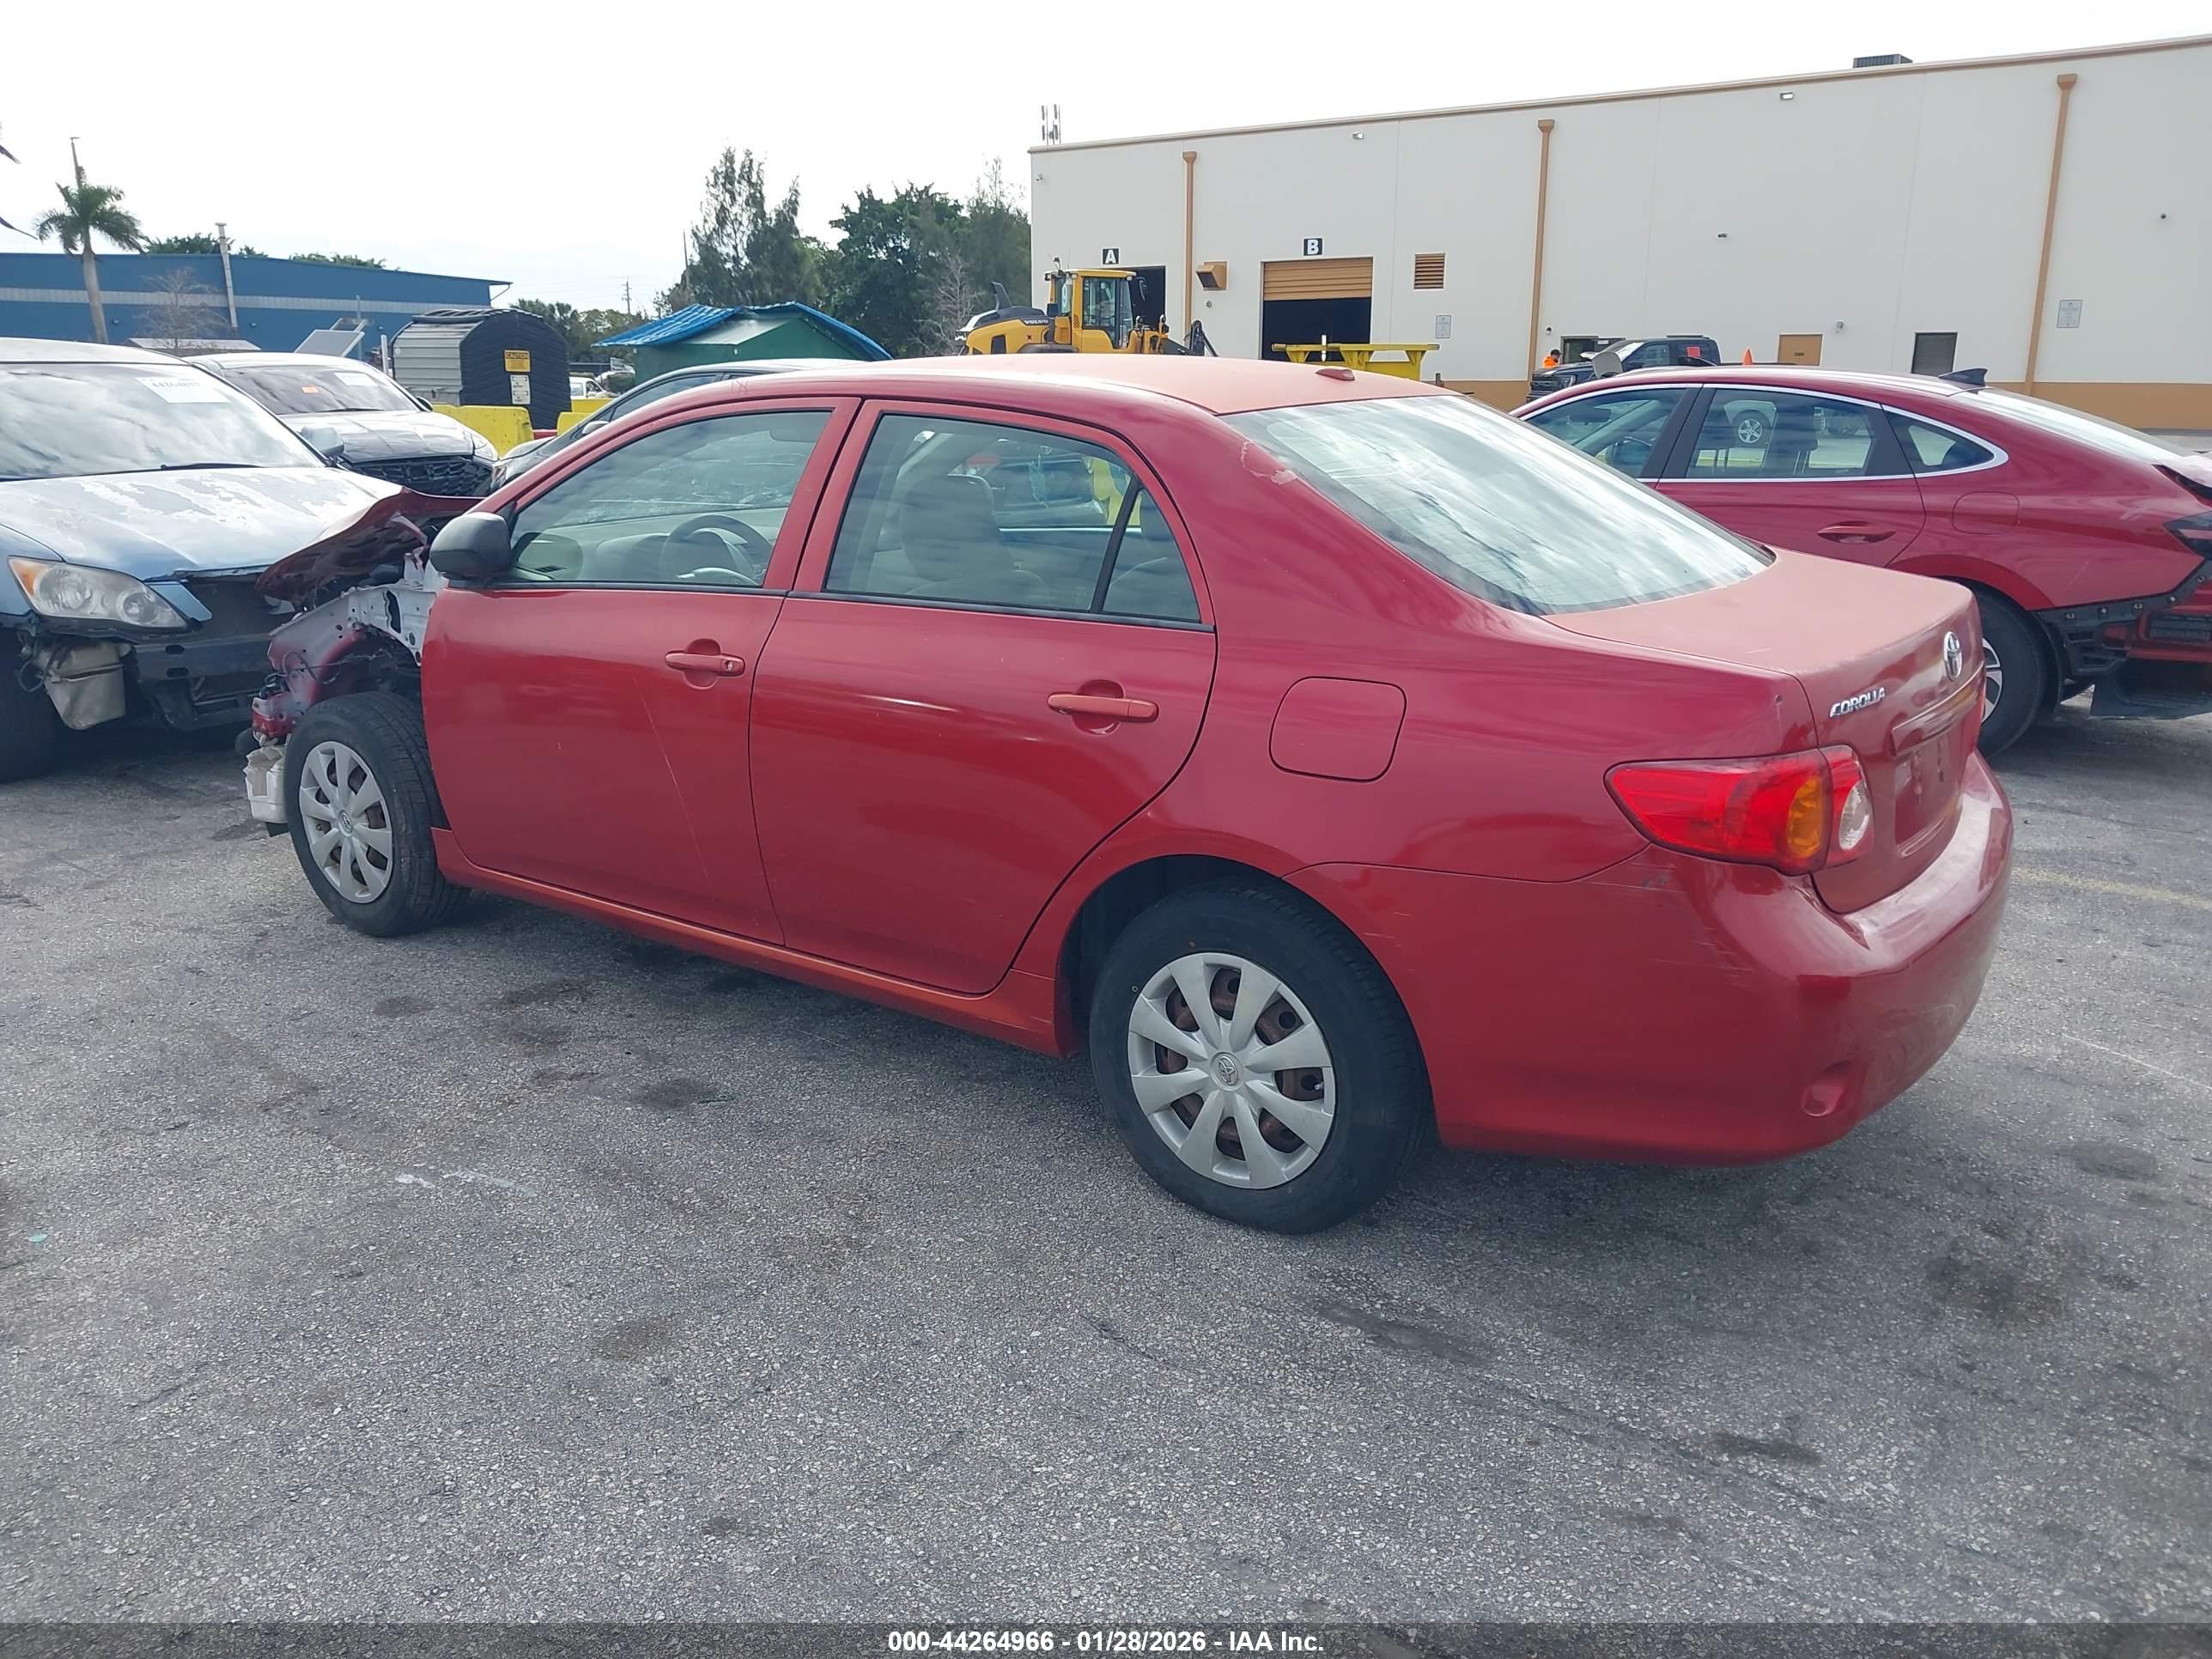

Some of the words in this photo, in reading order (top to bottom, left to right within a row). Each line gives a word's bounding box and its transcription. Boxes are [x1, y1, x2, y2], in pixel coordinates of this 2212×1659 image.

[1307, 239, 1319, 255] B
[1105, 249, 1116, 264] A
[1829, 687, 1885, 718] COROLLA
